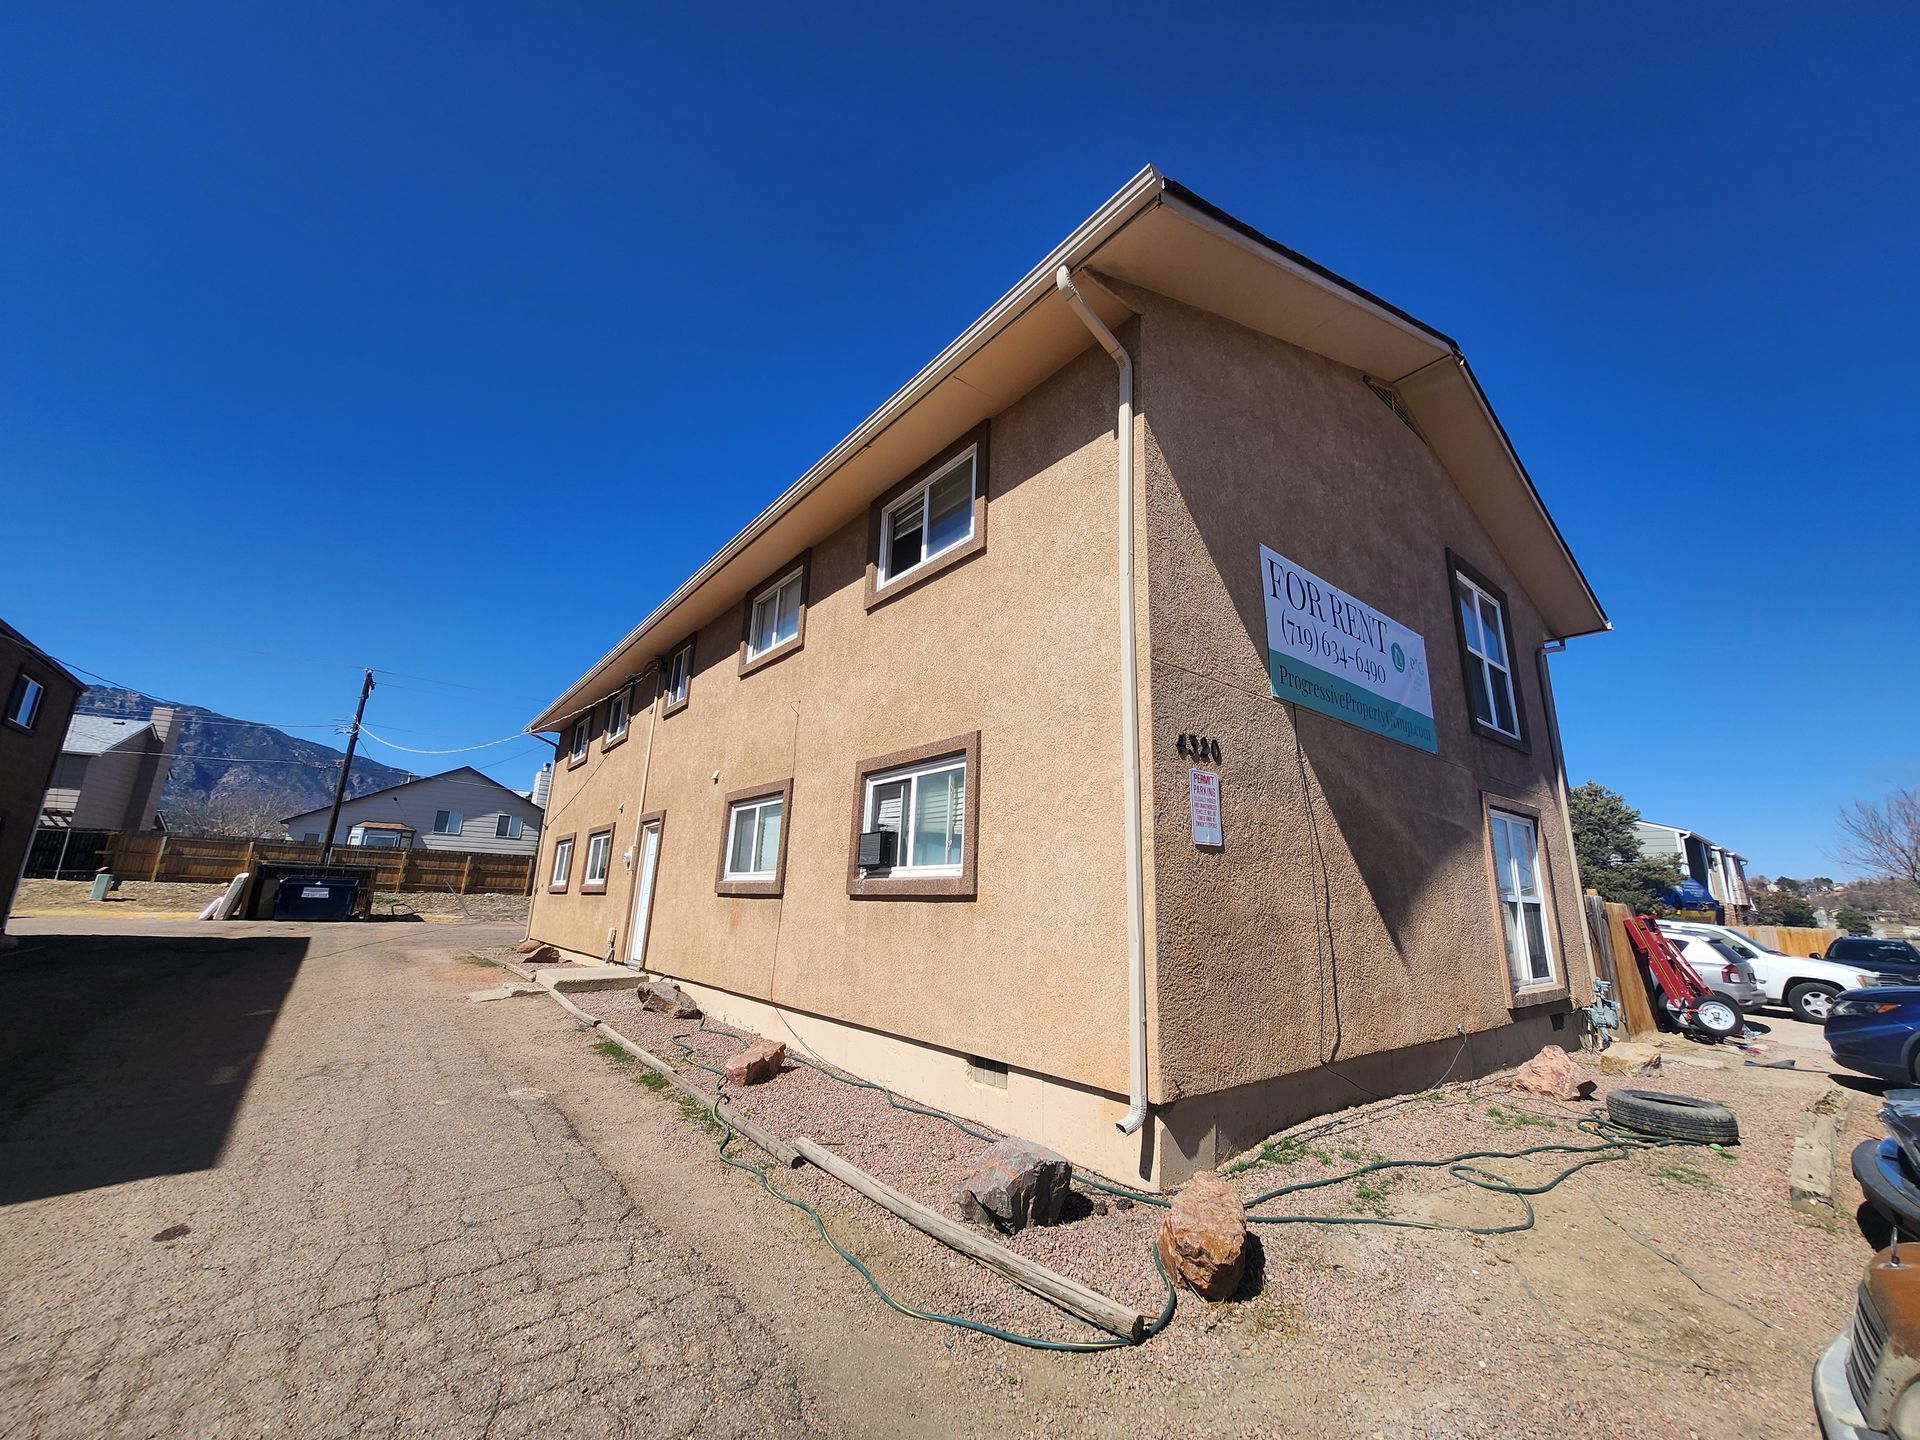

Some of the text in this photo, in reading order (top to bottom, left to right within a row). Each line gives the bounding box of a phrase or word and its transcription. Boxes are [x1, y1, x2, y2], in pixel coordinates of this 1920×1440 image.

[1267, 558, 1388, 654] FOR RENT
[1193, 773, 1214, 785] PERMIT
[1193, 785, 1216, 797] PARKING
